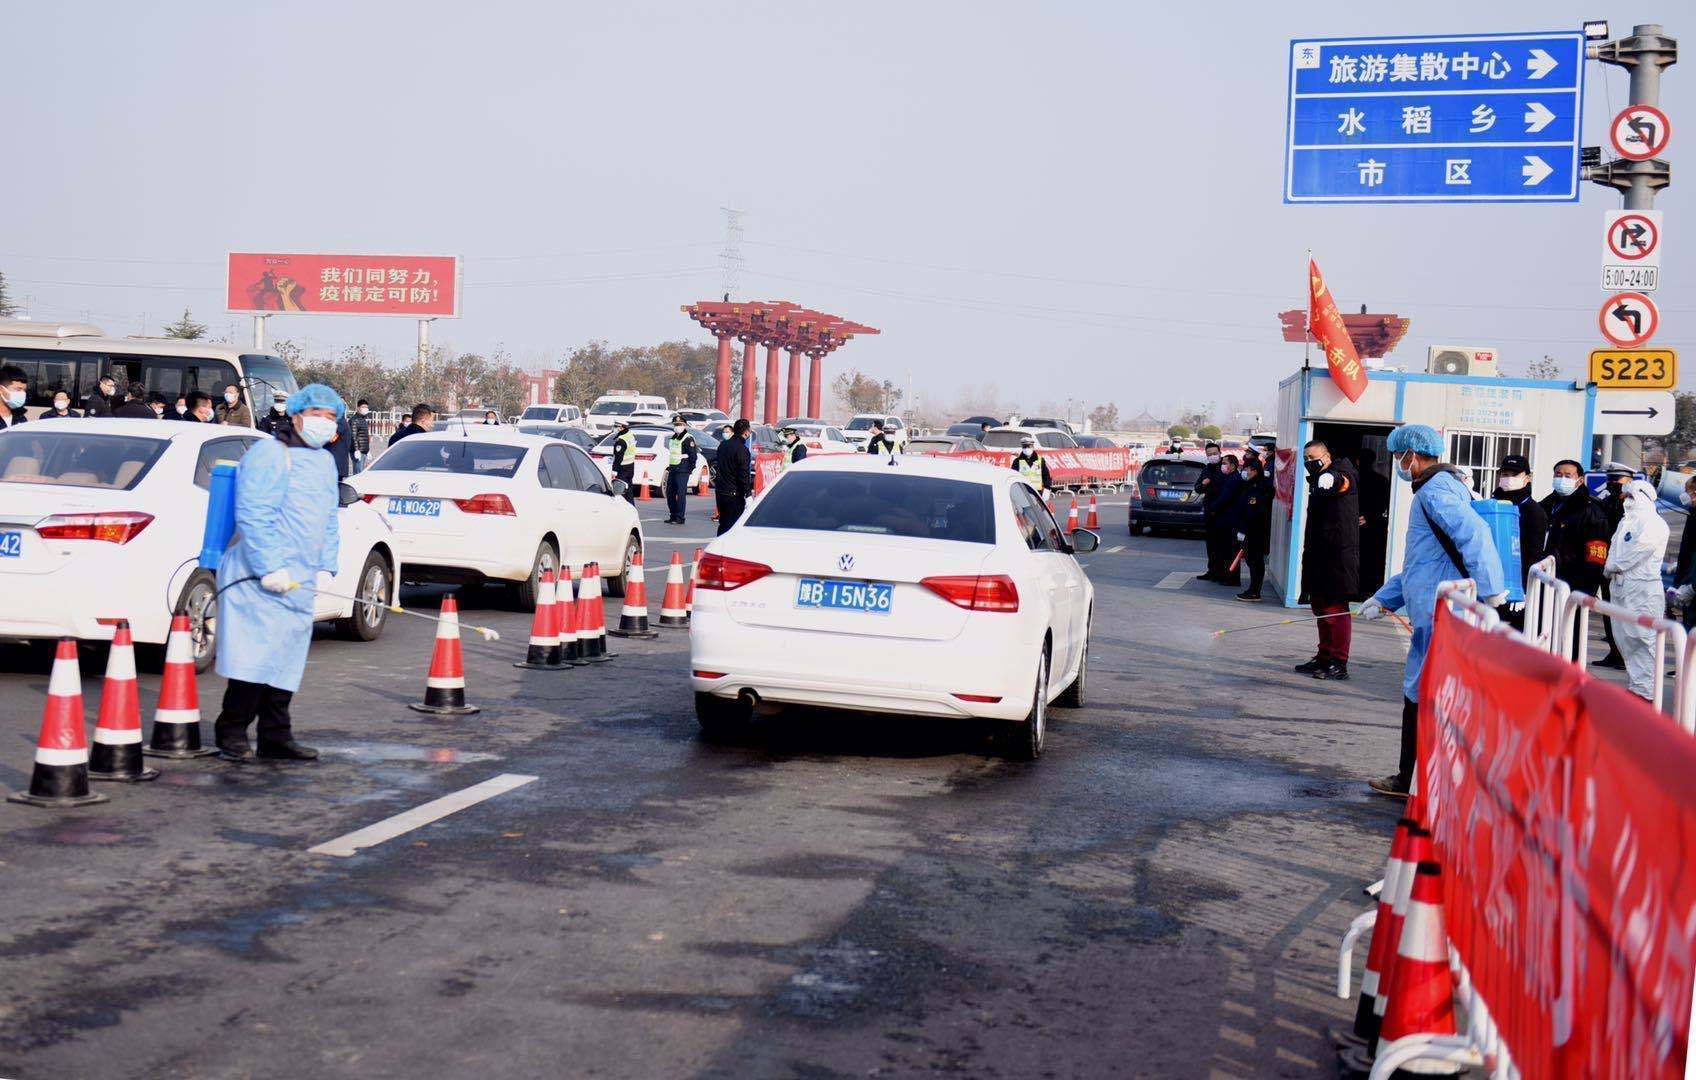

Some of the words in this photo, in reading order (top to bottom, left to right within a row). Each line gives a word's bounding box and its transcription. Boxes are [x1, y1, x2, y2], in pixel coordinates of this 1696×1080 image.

[1329, 52, 1512, 84] 旅游集散中心
[1337, 104, 1497, 136] 水稻乡
[1357, 158, 1473, 187] 市区
[1606, 269, 1655, 287] 5:00-24:00
[1601, 358, 1666, 381] S223
